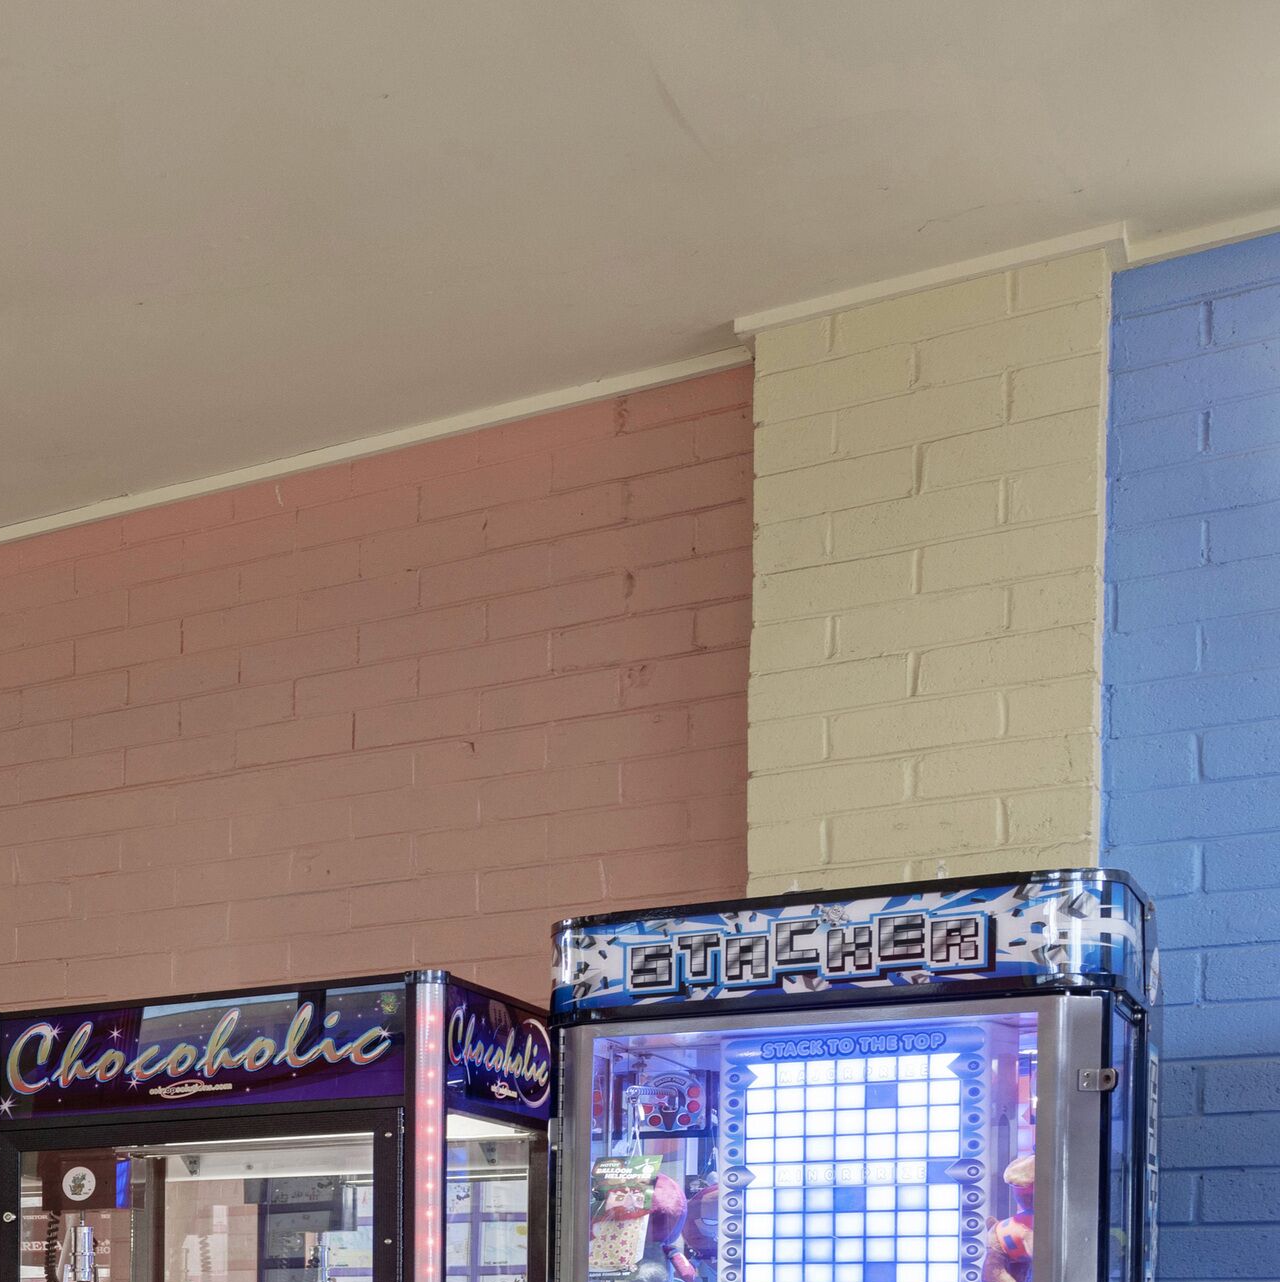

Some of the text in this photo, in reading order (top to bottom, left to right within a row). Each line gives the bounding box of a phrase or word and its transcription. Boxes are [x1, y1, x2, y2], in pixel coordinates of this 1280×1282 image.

[629, 912, 983, 989] STACKER
[6, 1001, 392, 1096] Chocoholic
[448, 1006, 549, 1087] Chocoholic
[761, 1032, 946, 1059] STACK TO THE TOP
